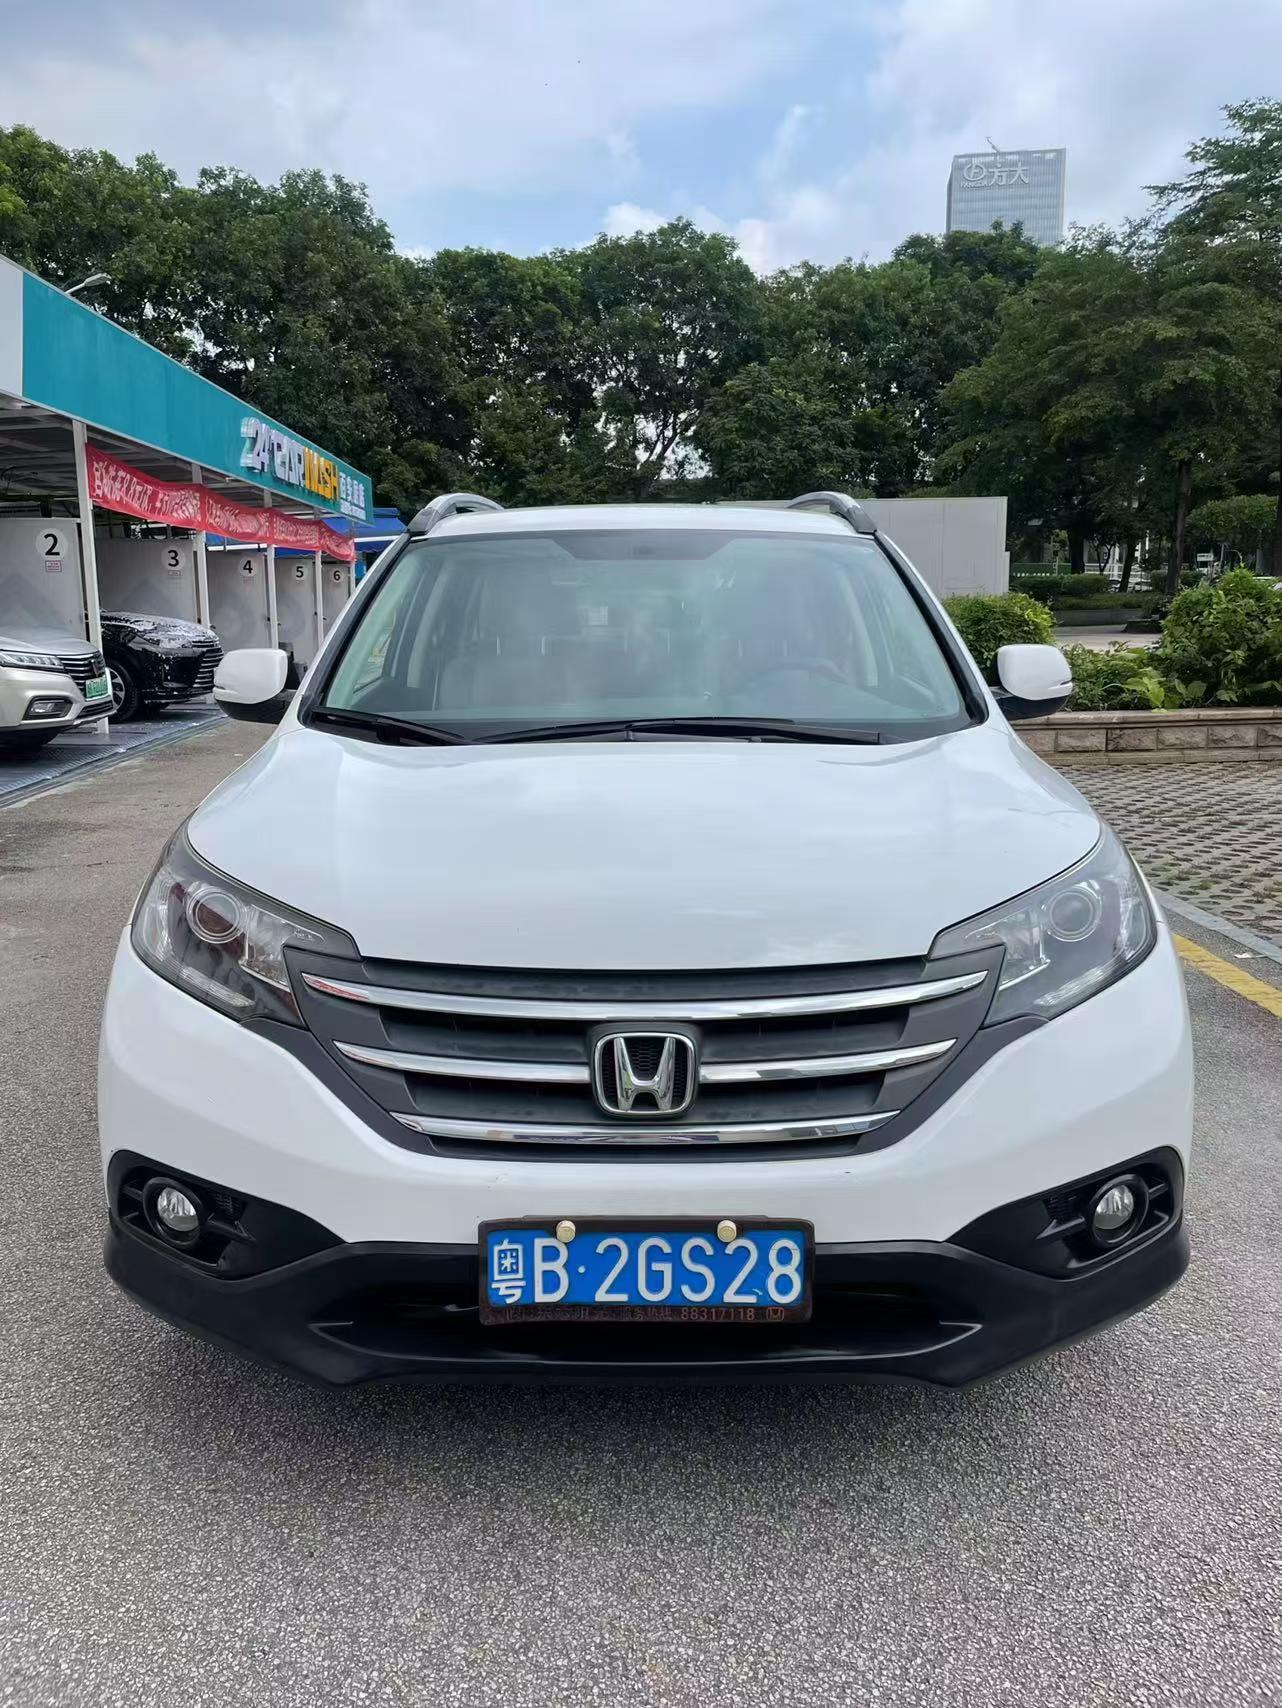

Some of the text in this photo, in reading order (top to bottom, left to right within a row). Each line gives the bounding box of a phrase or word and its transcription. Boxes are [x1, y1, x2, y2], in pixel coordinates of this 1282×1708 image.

[988, 162, 1029, 187] 方大
[44, 533, 60, 556] 2
[167, 549, 180, 567] 3
[242, 560, 253, 574] 4
[295, 566, 304, 578] 5
[333, 570, 341, 581] 6
[680, 1306, 756, 1321] 88317118
